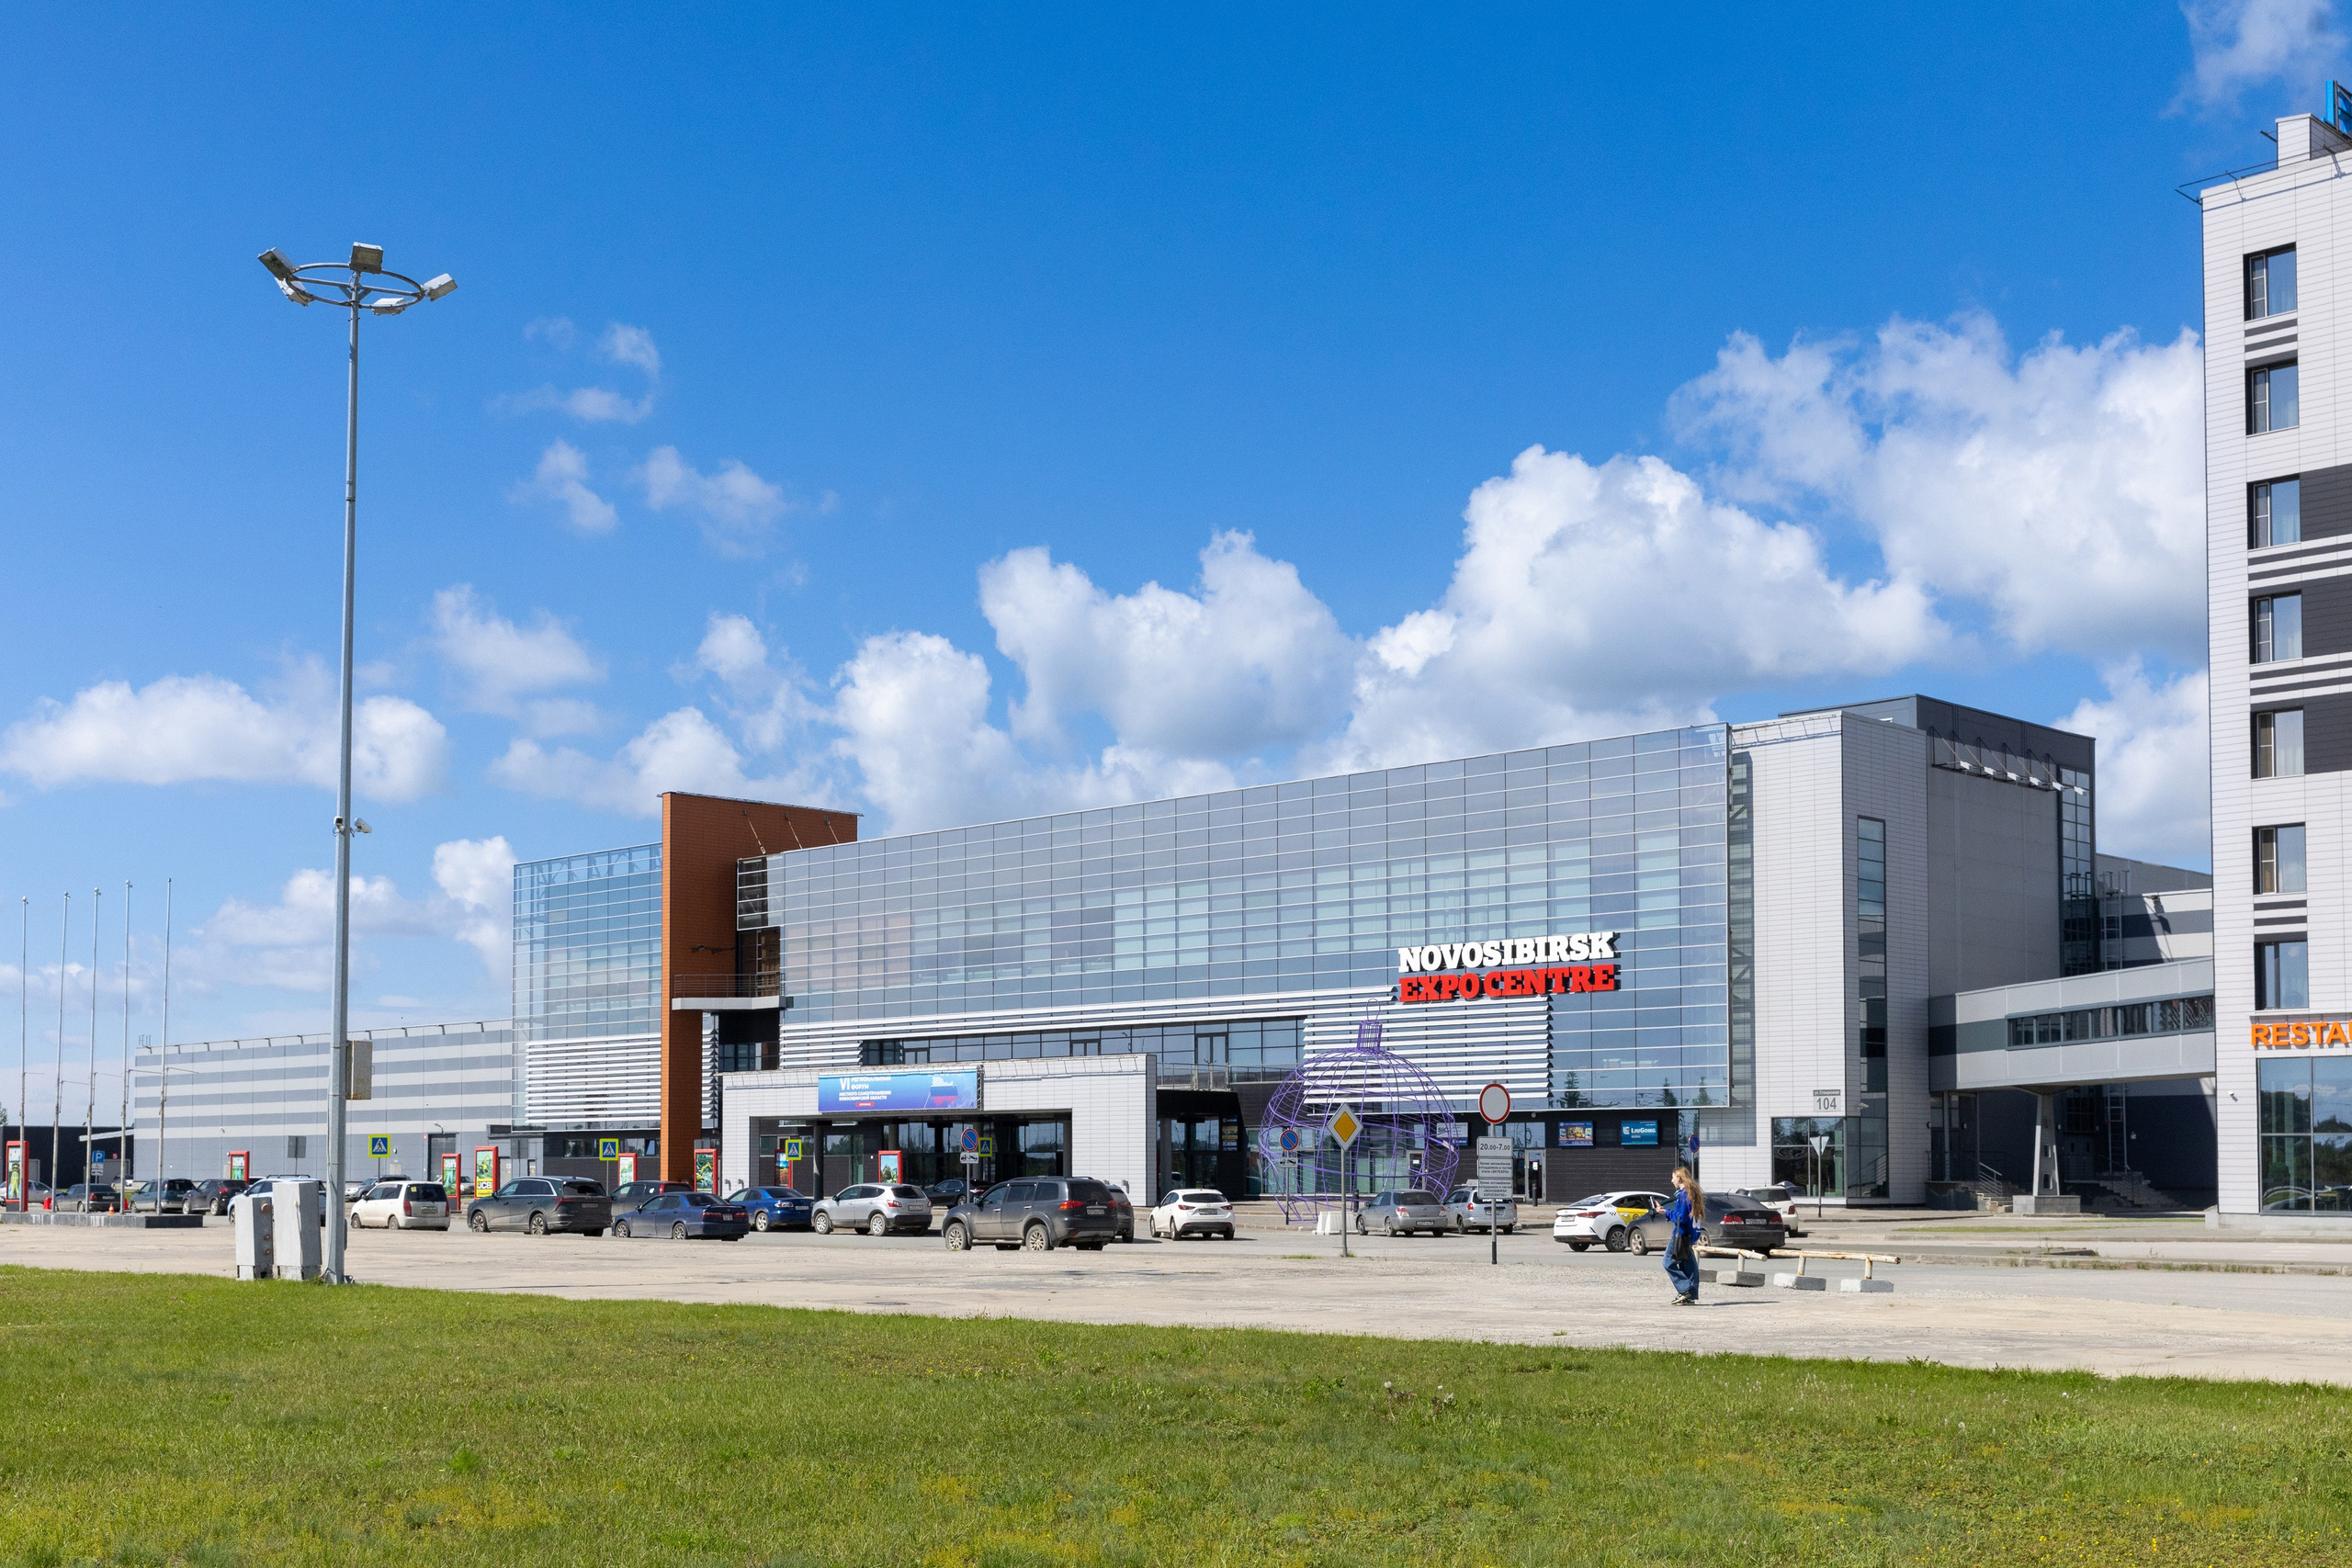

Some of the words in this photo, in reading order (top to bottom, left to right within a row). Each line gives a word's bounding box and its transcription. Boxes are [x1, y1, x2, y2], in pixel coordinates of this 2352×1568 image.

[1398, 931, 1615, 973] NOVOSIBIRSK
[840, 1077, 850, 1090] VI
[1816, 1097, 1838, 1110] 104
[478, 1181, 492, 1190] JCB
